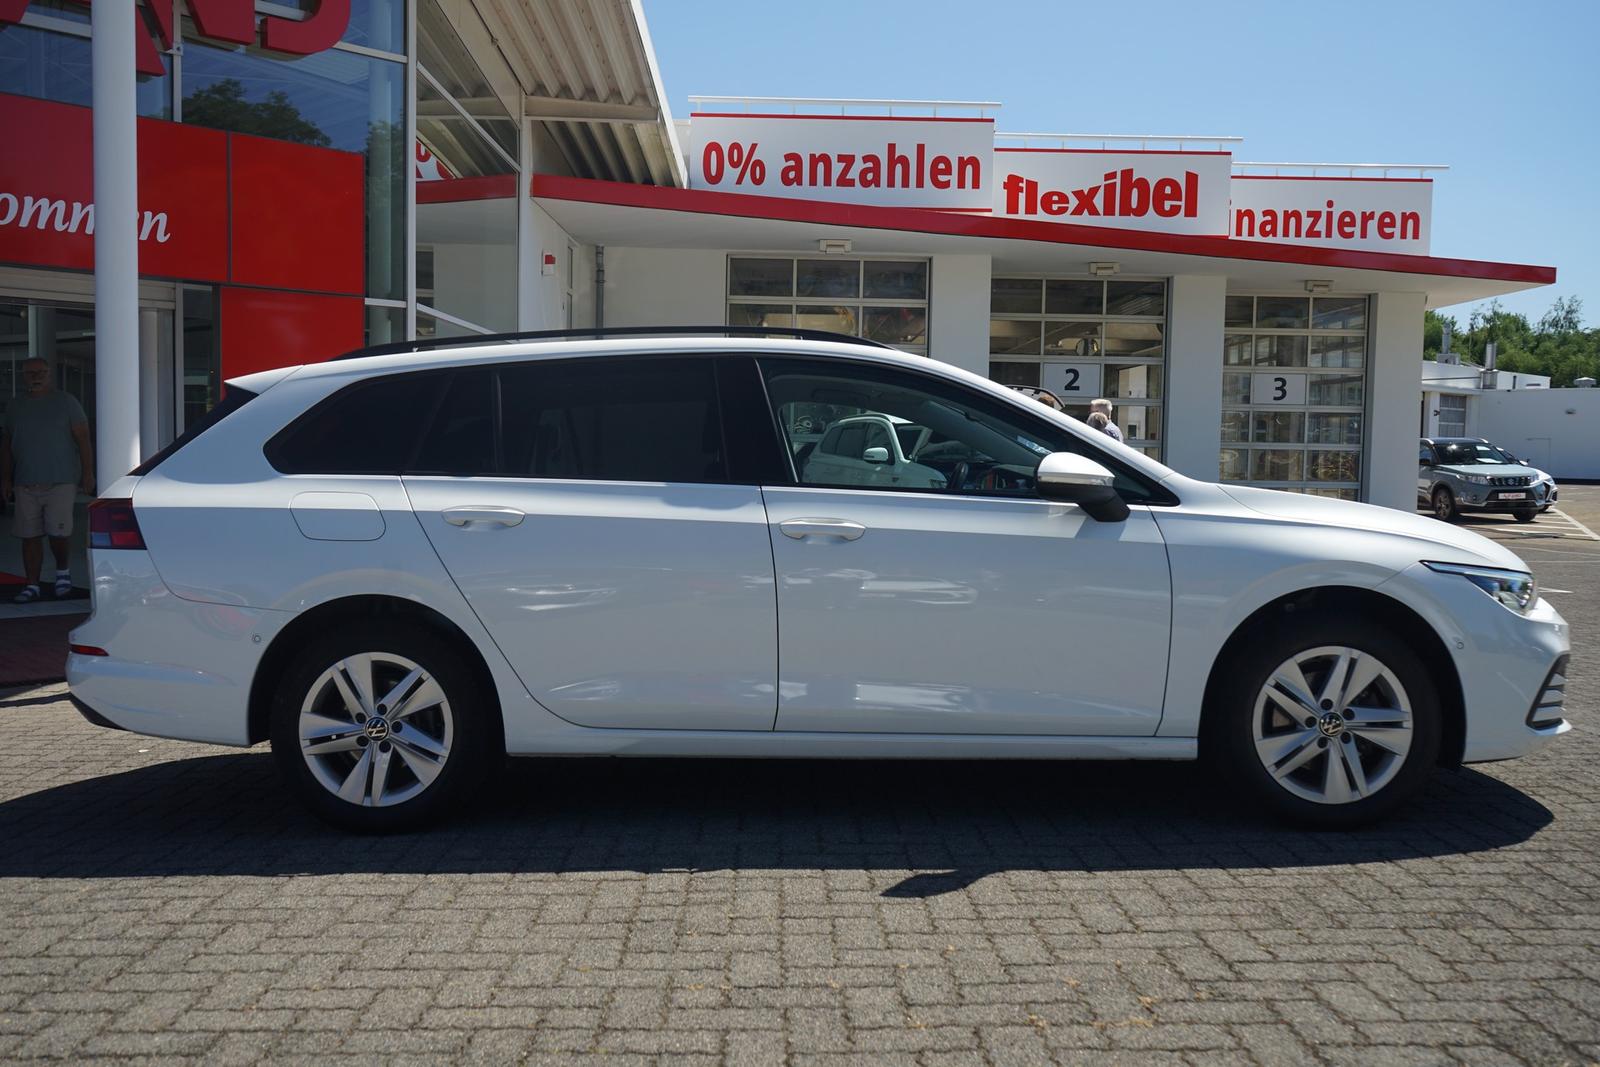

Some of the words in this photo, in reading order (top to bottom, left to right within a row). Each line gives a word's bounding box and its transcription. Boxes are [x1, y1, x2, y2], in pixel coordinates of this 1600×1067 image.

[703, 141, 766, 186] 0%
[780, 143, 981, 190] anzahlen
[1002, 168, 1199, 219] flexibel
[1228, 199, 1421, 241] nanzieren
[1063, 367, 1081, 392] 2
[1272, 376, 1288, 402] 3
